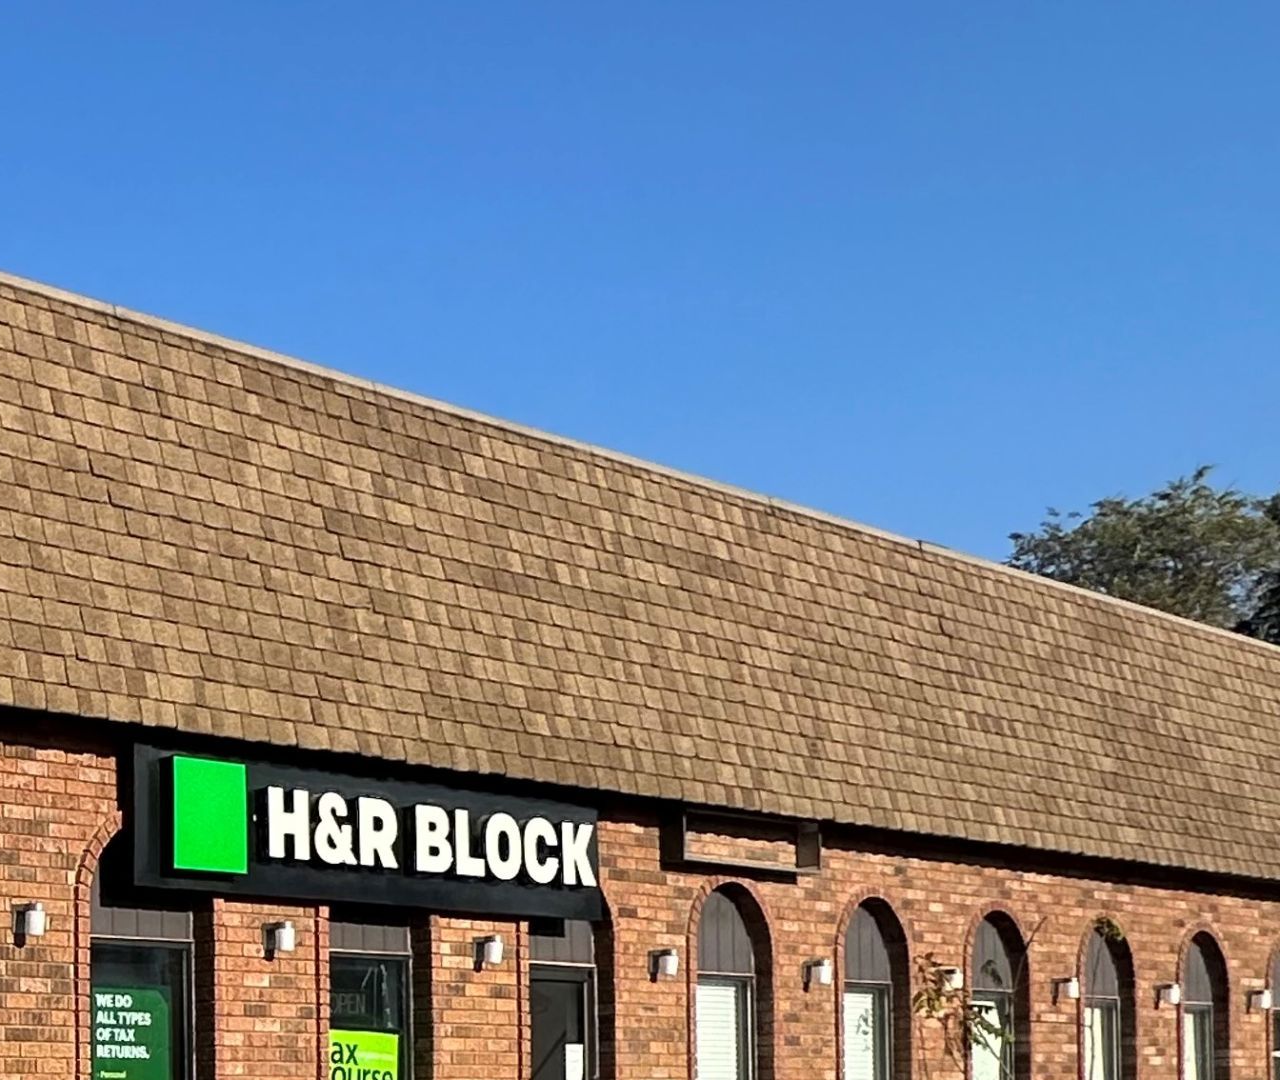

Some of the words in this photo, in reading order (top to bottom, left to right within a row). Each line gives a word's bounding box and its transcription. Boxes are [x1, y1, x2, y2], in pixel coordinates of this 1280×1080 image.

[267, 785, 399, 869] H&R
[415, 803, 597, 887] BLOCK
[95, 993, 114, 1008] WE
[115, 994, 132, 1008] DO
[96, 1010, 116, 1025] ALL
[118, 1012, 151, 1026] TYPES
[96, 1028, 114, 1042] OF
[114, 1028, 135, 1042] TAX
[96, 1045, 151, 1060] RETURNS.
